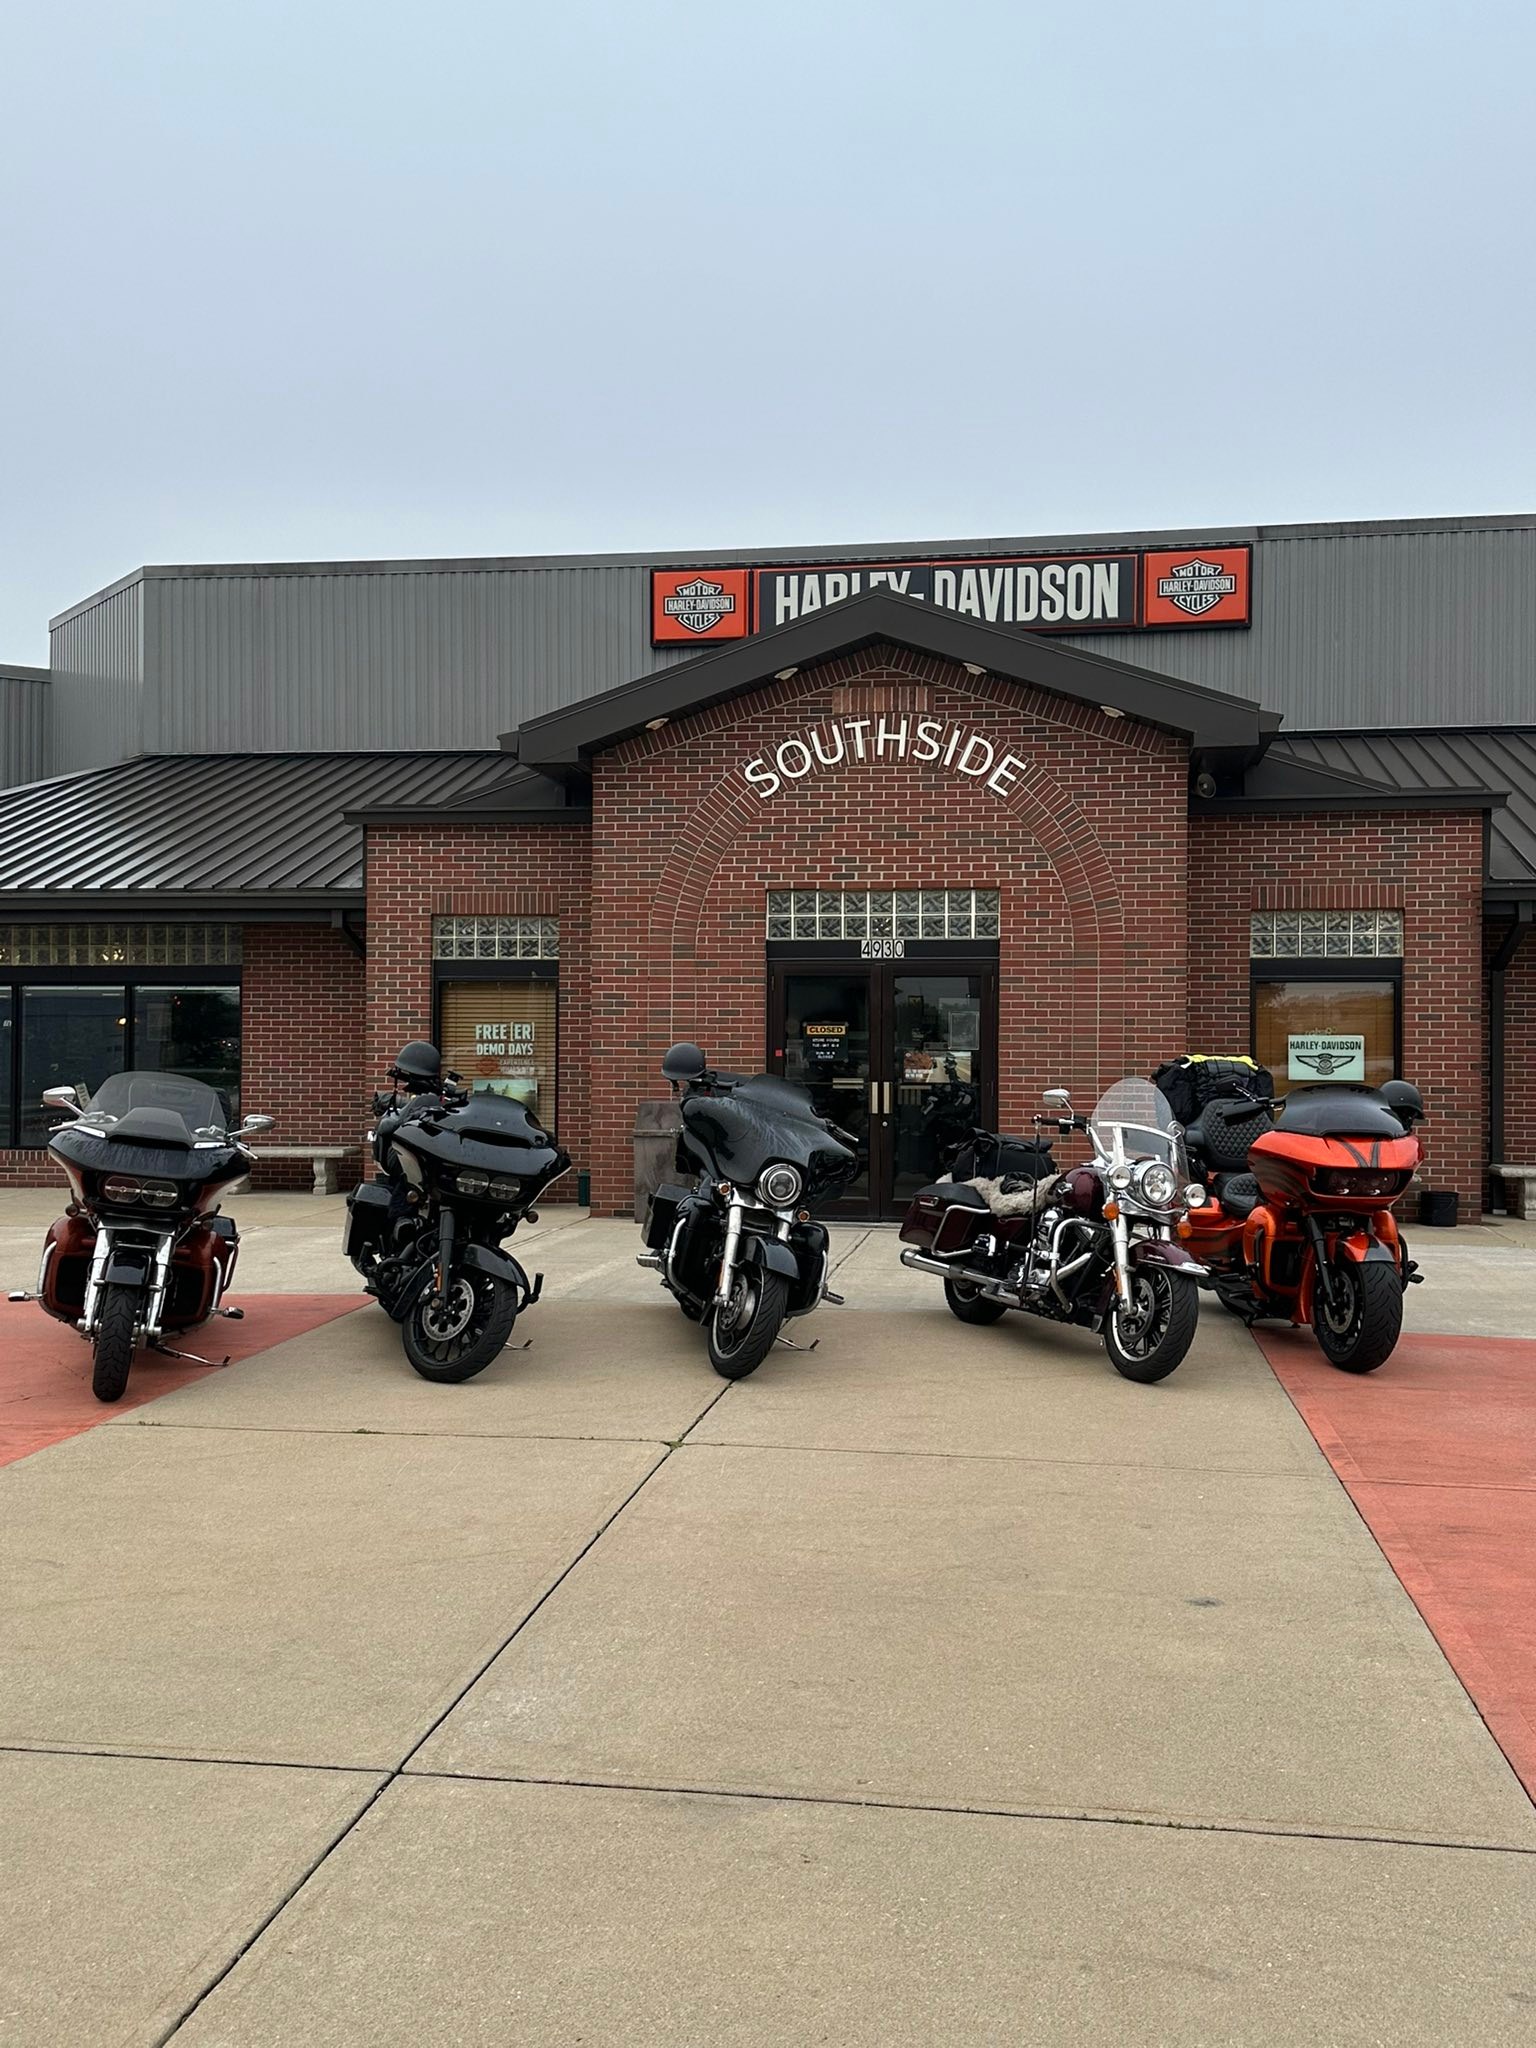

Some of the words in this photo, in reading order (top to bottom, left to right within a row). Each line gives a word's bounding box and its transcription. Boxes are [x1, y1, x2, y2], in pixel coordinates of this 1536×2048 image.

[1179, 563, 1215, 577] MOTOR
[683, 582, 716, 596] MOTOR
[1163, 578, 1231, 593] HARLEY-DAVIDSON
[668, 598, 731, 612] HARLEY-DAVIDSON
[1179, 594, 1216, 611] CYCLES
[683, 613, 716, 629] CYCLES
[744, 718, 1027, 799] SOUTHSIDE
[861, 940, 904, 958] 4930
[475, 1023, 508, 1040] FREE
[809, 1026, 843, 1034] CLOSED
[476, 1043, 505, 1056] DEMO
[508, 1043, 534, 1056] DAYS
[1289, 1040, 1362, 1051] HARLEY-DAVIDSON
